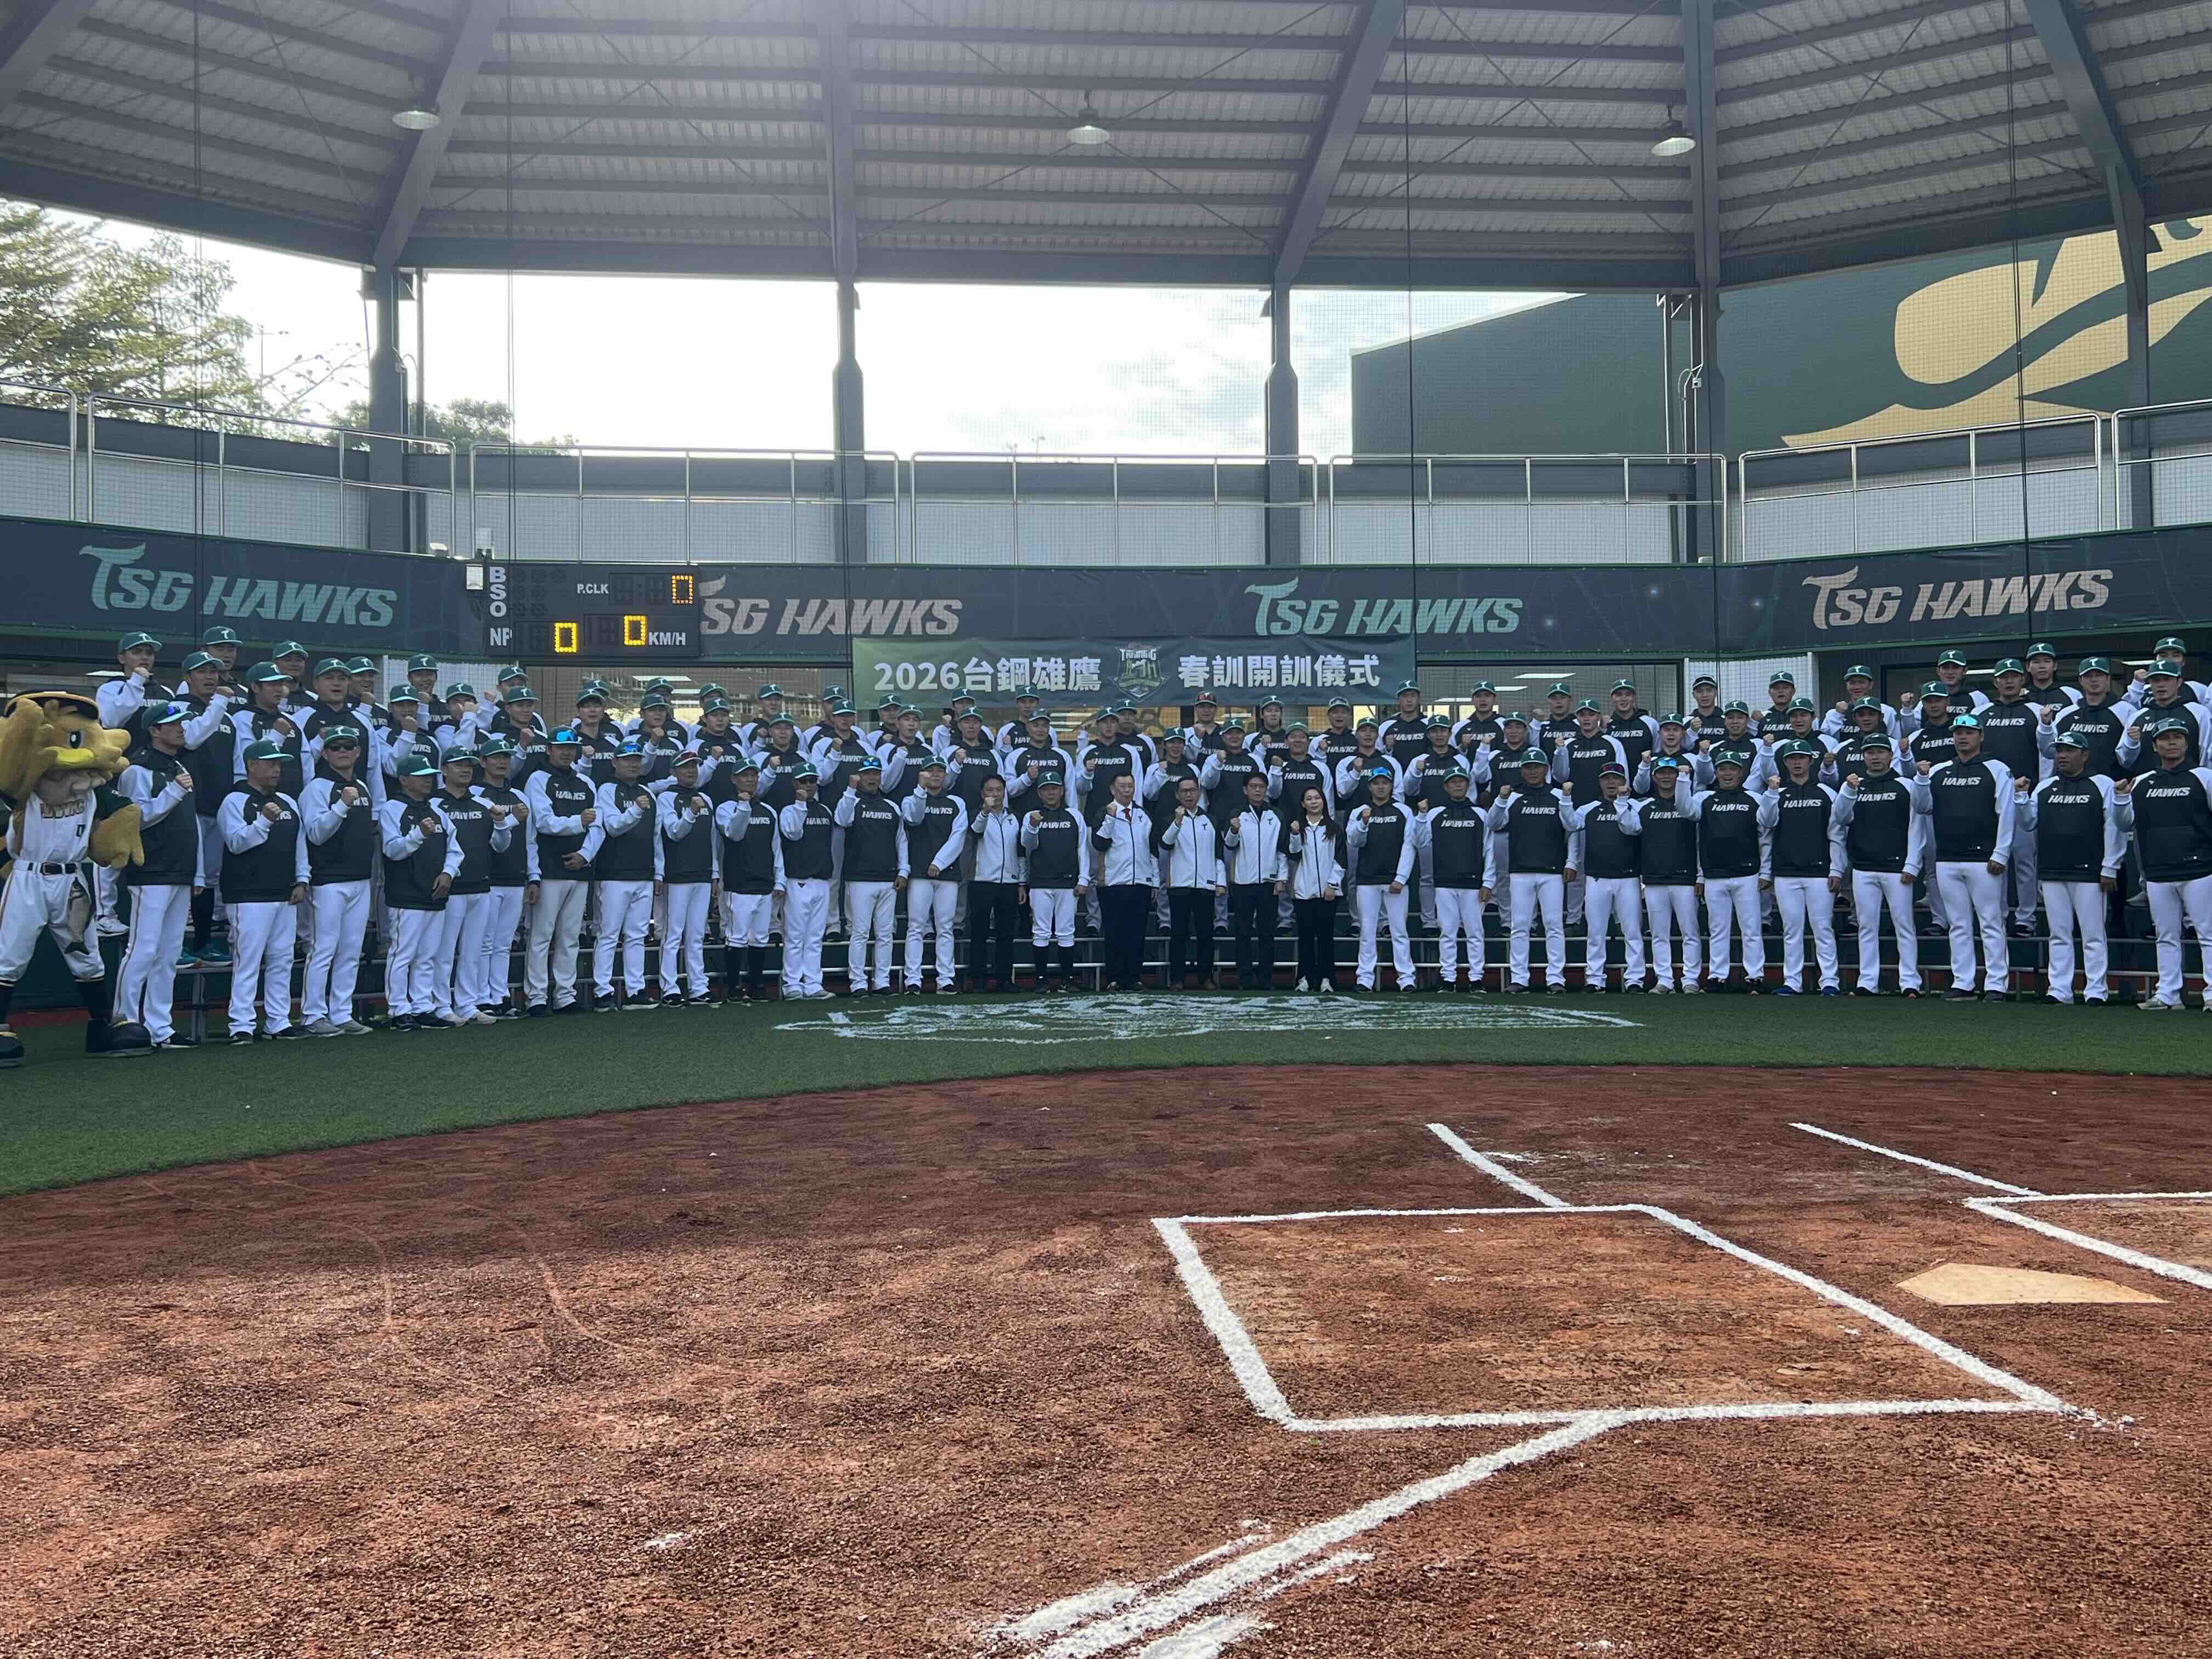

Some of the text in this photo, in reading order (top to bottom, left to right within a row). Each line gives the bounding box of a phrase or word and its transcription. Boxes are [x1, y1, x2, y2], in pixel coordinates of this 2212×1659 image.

[79, 542, 398, 627] TSG HAWKS
[490, 567, 506, 583] B
[577, 584, 609, 594] P.CLK
[672, 574, 693, 604] 0
[490, 584, 506, 600] S
[699, 575, 962, 634] SG HAWKS
[1245, 577, 1523, 636] TSG HAWKS
[1802, 566, 2113, 630] TSG HAWKS
[490, 601, 506, 617] O
[490, 628, 512, 646] NP
[555, 622, 578, 653] 0
[624, 614, 647, 645] 0
[648, 631, 686, 645] KM/H
[874, 657, 1101, 692] 2026台鋼雄鷹
[1178, 654, 1380, 687] 春訓開訓儀式
